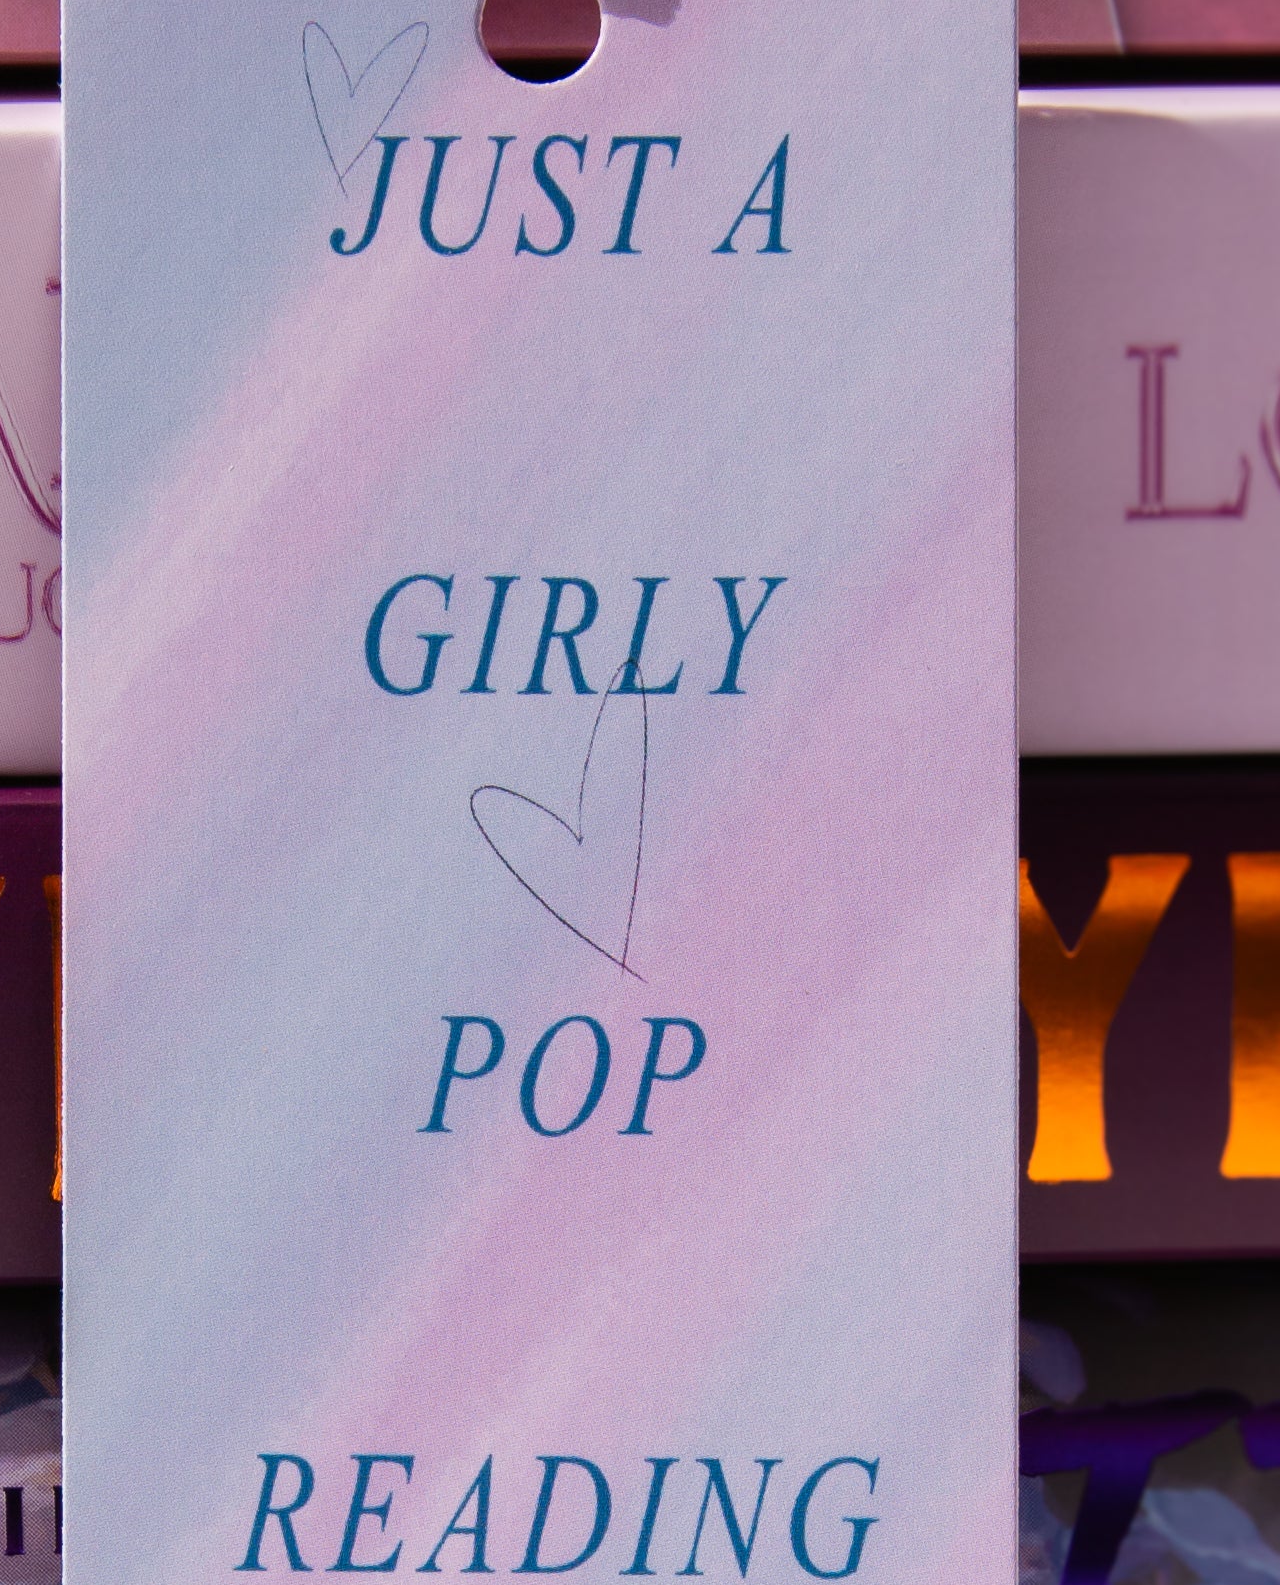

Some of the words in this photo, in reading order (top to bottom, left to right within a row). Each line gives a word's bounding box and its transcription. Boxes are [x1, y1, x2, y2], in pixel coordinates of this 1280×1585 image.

[328, 132, 683, 257] JUST
[711, 132, 793, 255] A
[363, 572, 789, 697] GIRLY
[416, 1014, 709, 1138] POP
[233, 1452, 883, 1580] READING
